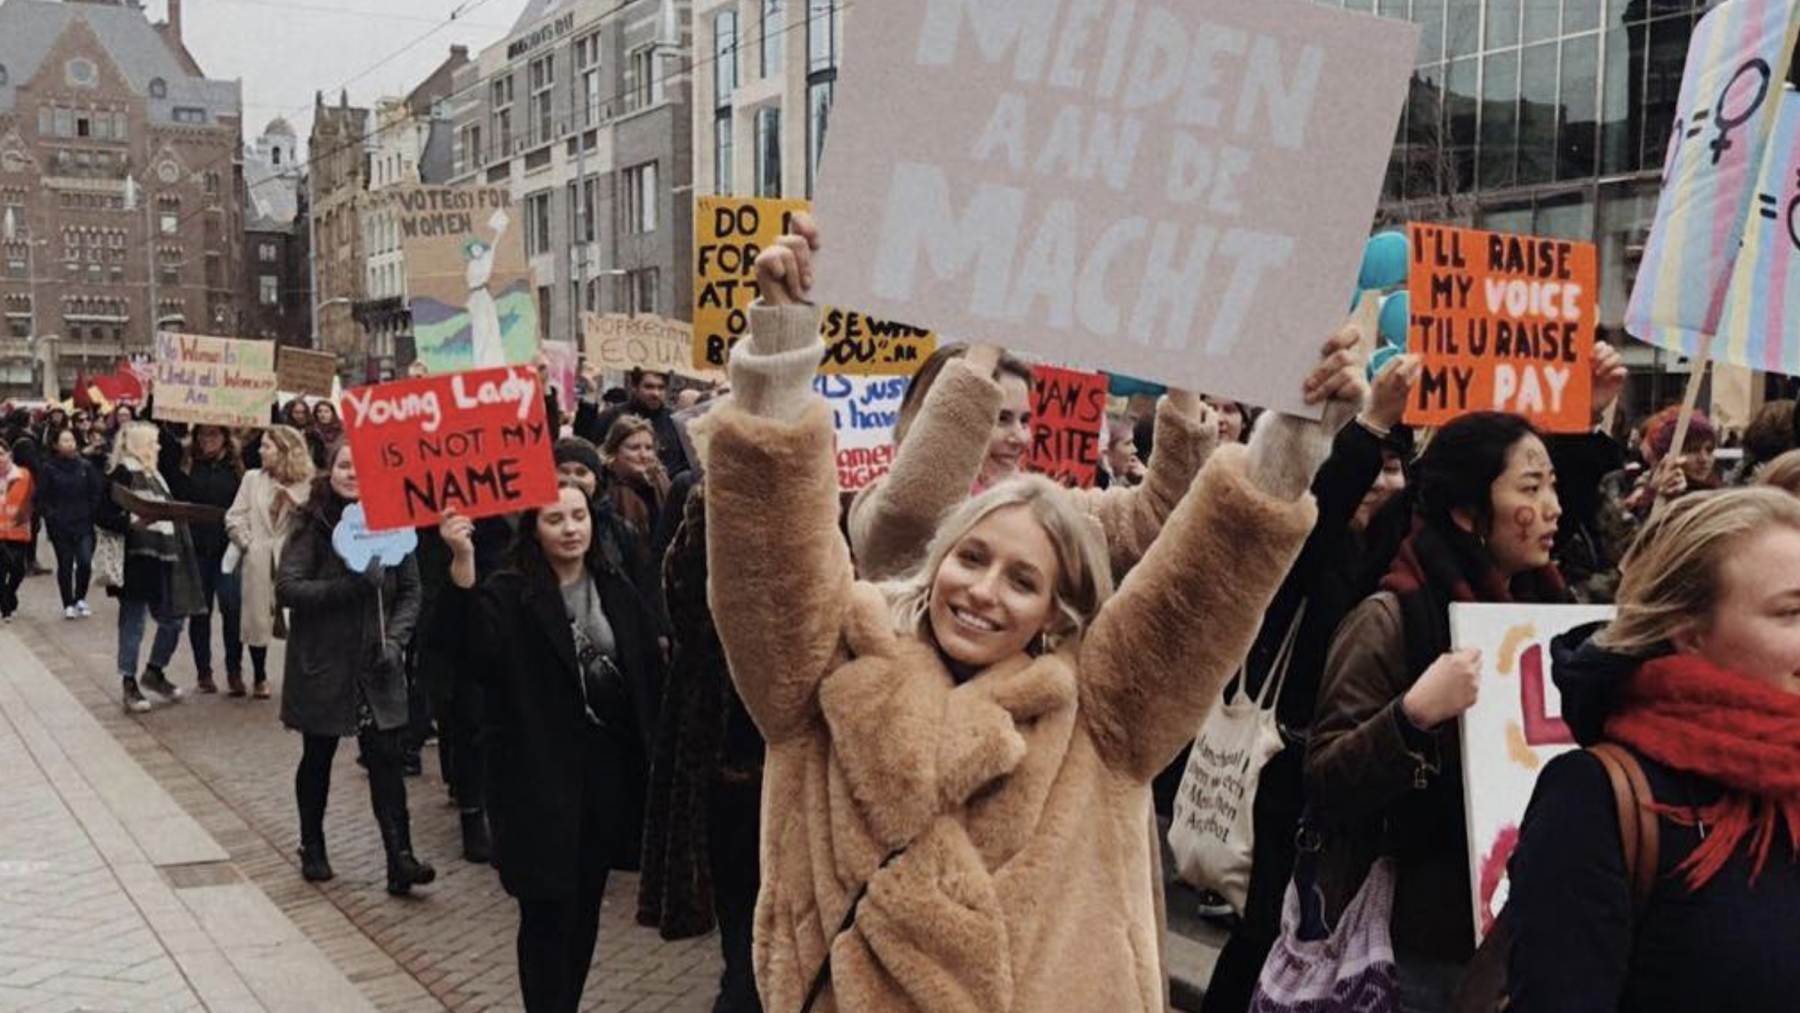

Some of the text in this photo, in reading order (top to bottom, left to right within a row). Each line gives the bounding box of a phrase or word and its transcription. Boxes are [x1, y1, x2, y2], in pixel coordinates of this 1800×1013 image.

[915, 0, 1322, 149] MEIDEN
[971, 90, 1254, 215] AAN DE
[477, 187, 512, 209] FOR
[401, 212, 472, 238] WOMEN
[870, 161, 1294, 357] MACHT
[1413, 227, 1572, 280] I'LL RAISE
[1431, 272, 1582, 320] MY VOICE
[820, 308, 863, 338] SE
[1469, 317, 1488, 357] U
[1495, 318, 1579, 363] RAISE
[601, 339, 686, 364] EQUA
[340, 366, 537, 432] Young Lady
[1418, 363, 1570, 414] MY PAY
[381, 421, 544, 468] IS NOT MY
[404, 458, 522, 520] NAME
